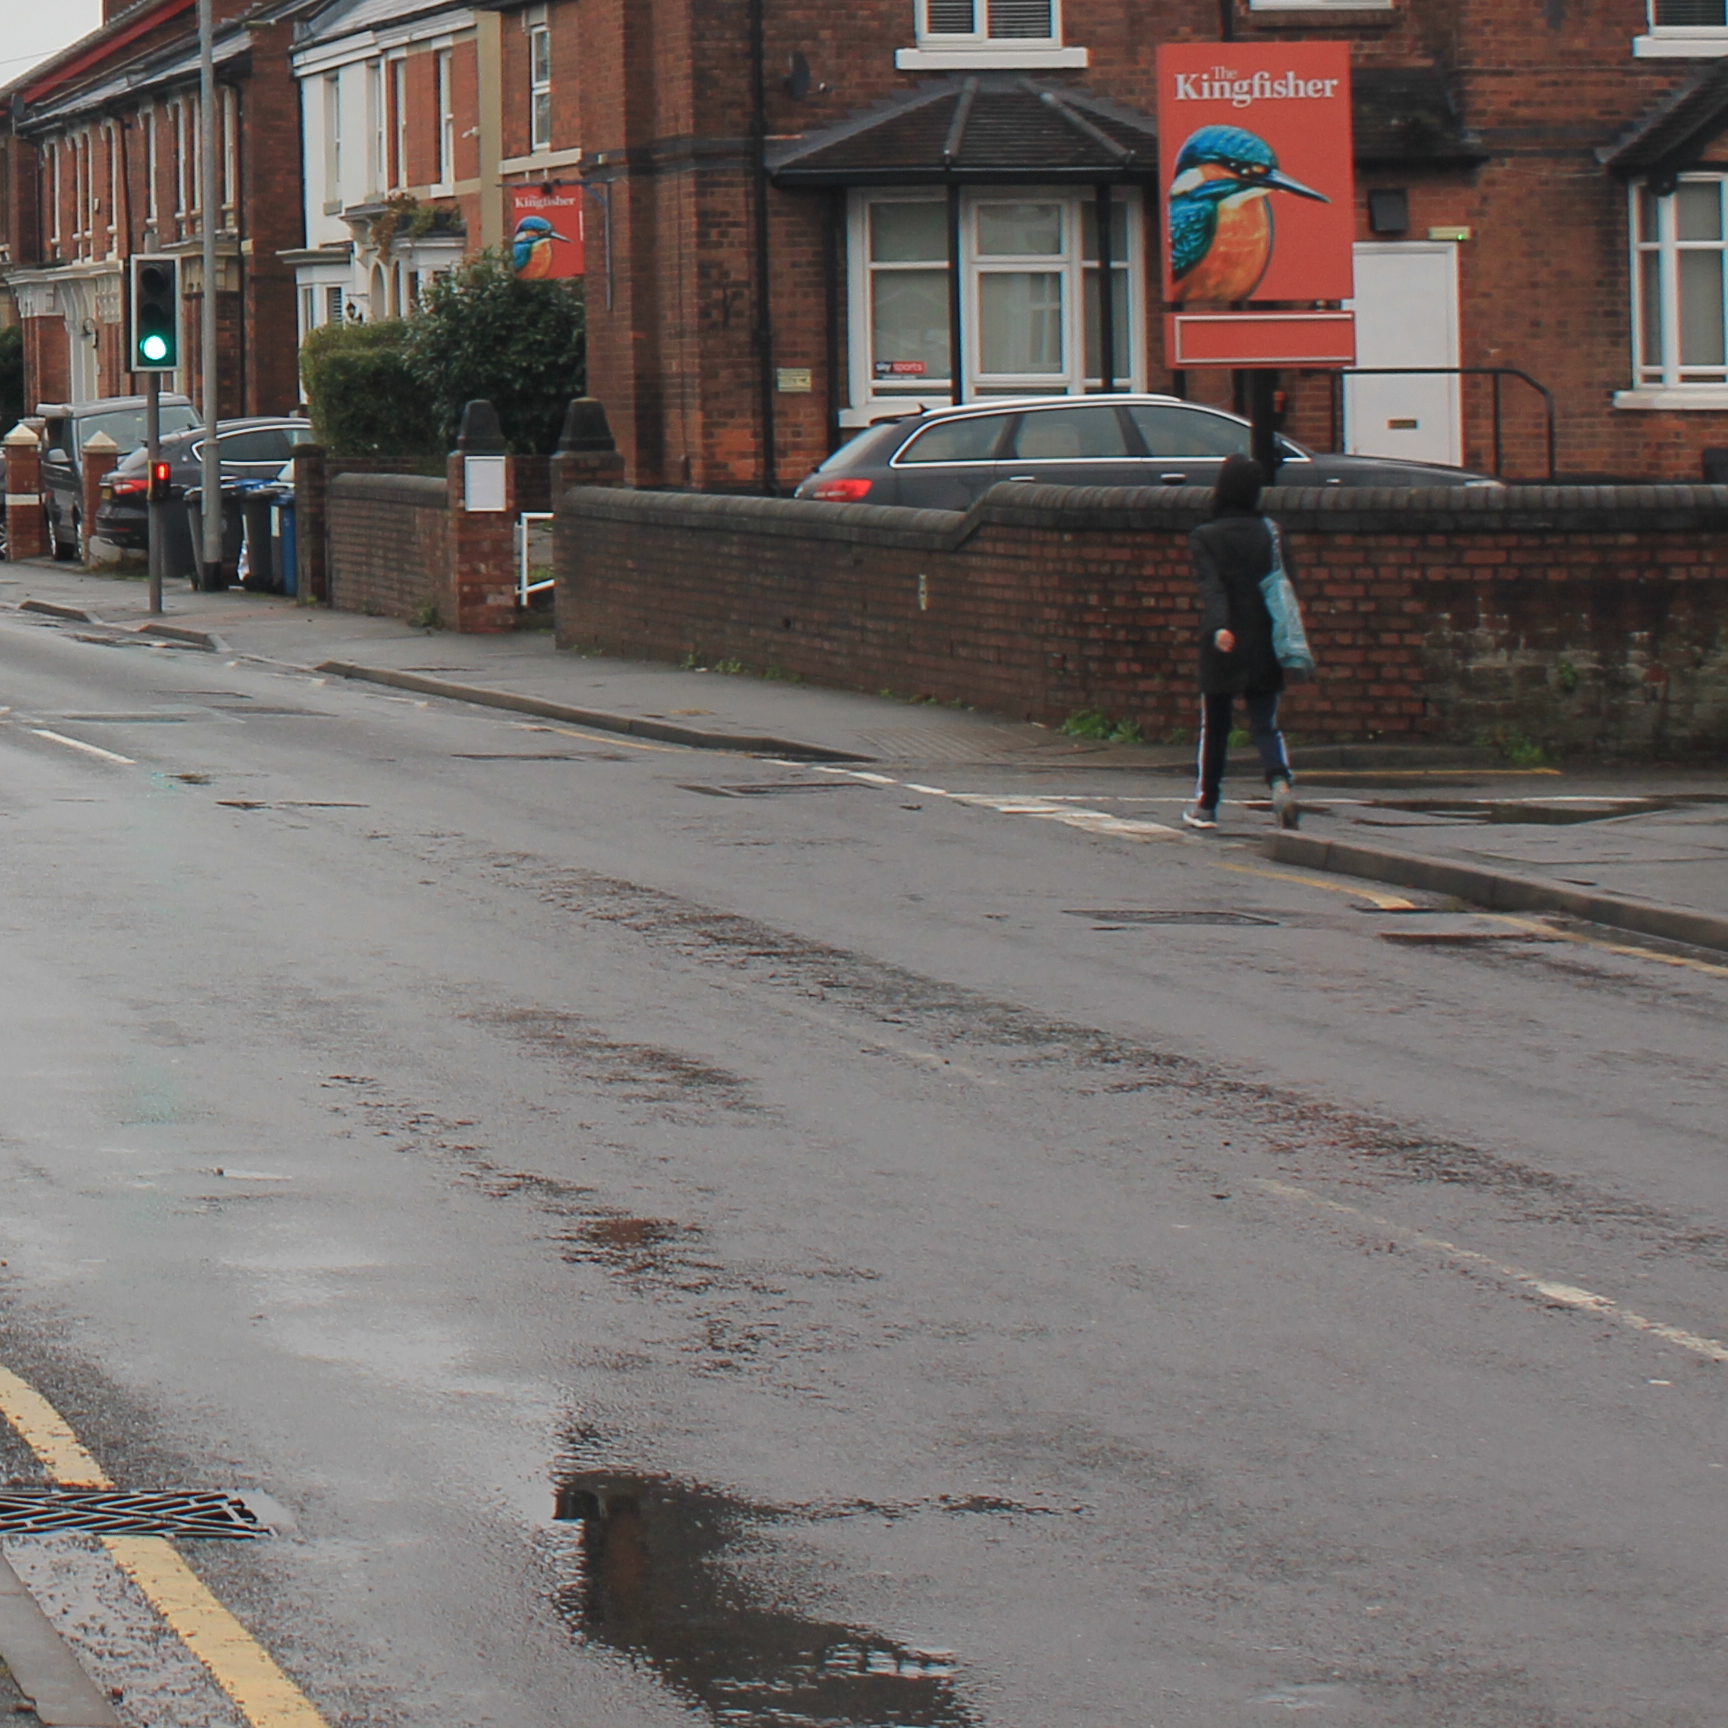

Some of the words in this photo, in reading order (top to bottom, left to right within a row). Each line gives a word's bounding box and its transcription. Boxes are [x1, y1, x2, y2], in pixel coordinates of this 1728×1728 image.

[1211, 65, 1238, 80] The
[1174, 71, 1339, 109] Kingfisher
[514, 195, 576, 210] Kingfisher
[875, 362, 892, 373] sky
[893, 362, 923, 373] sports
